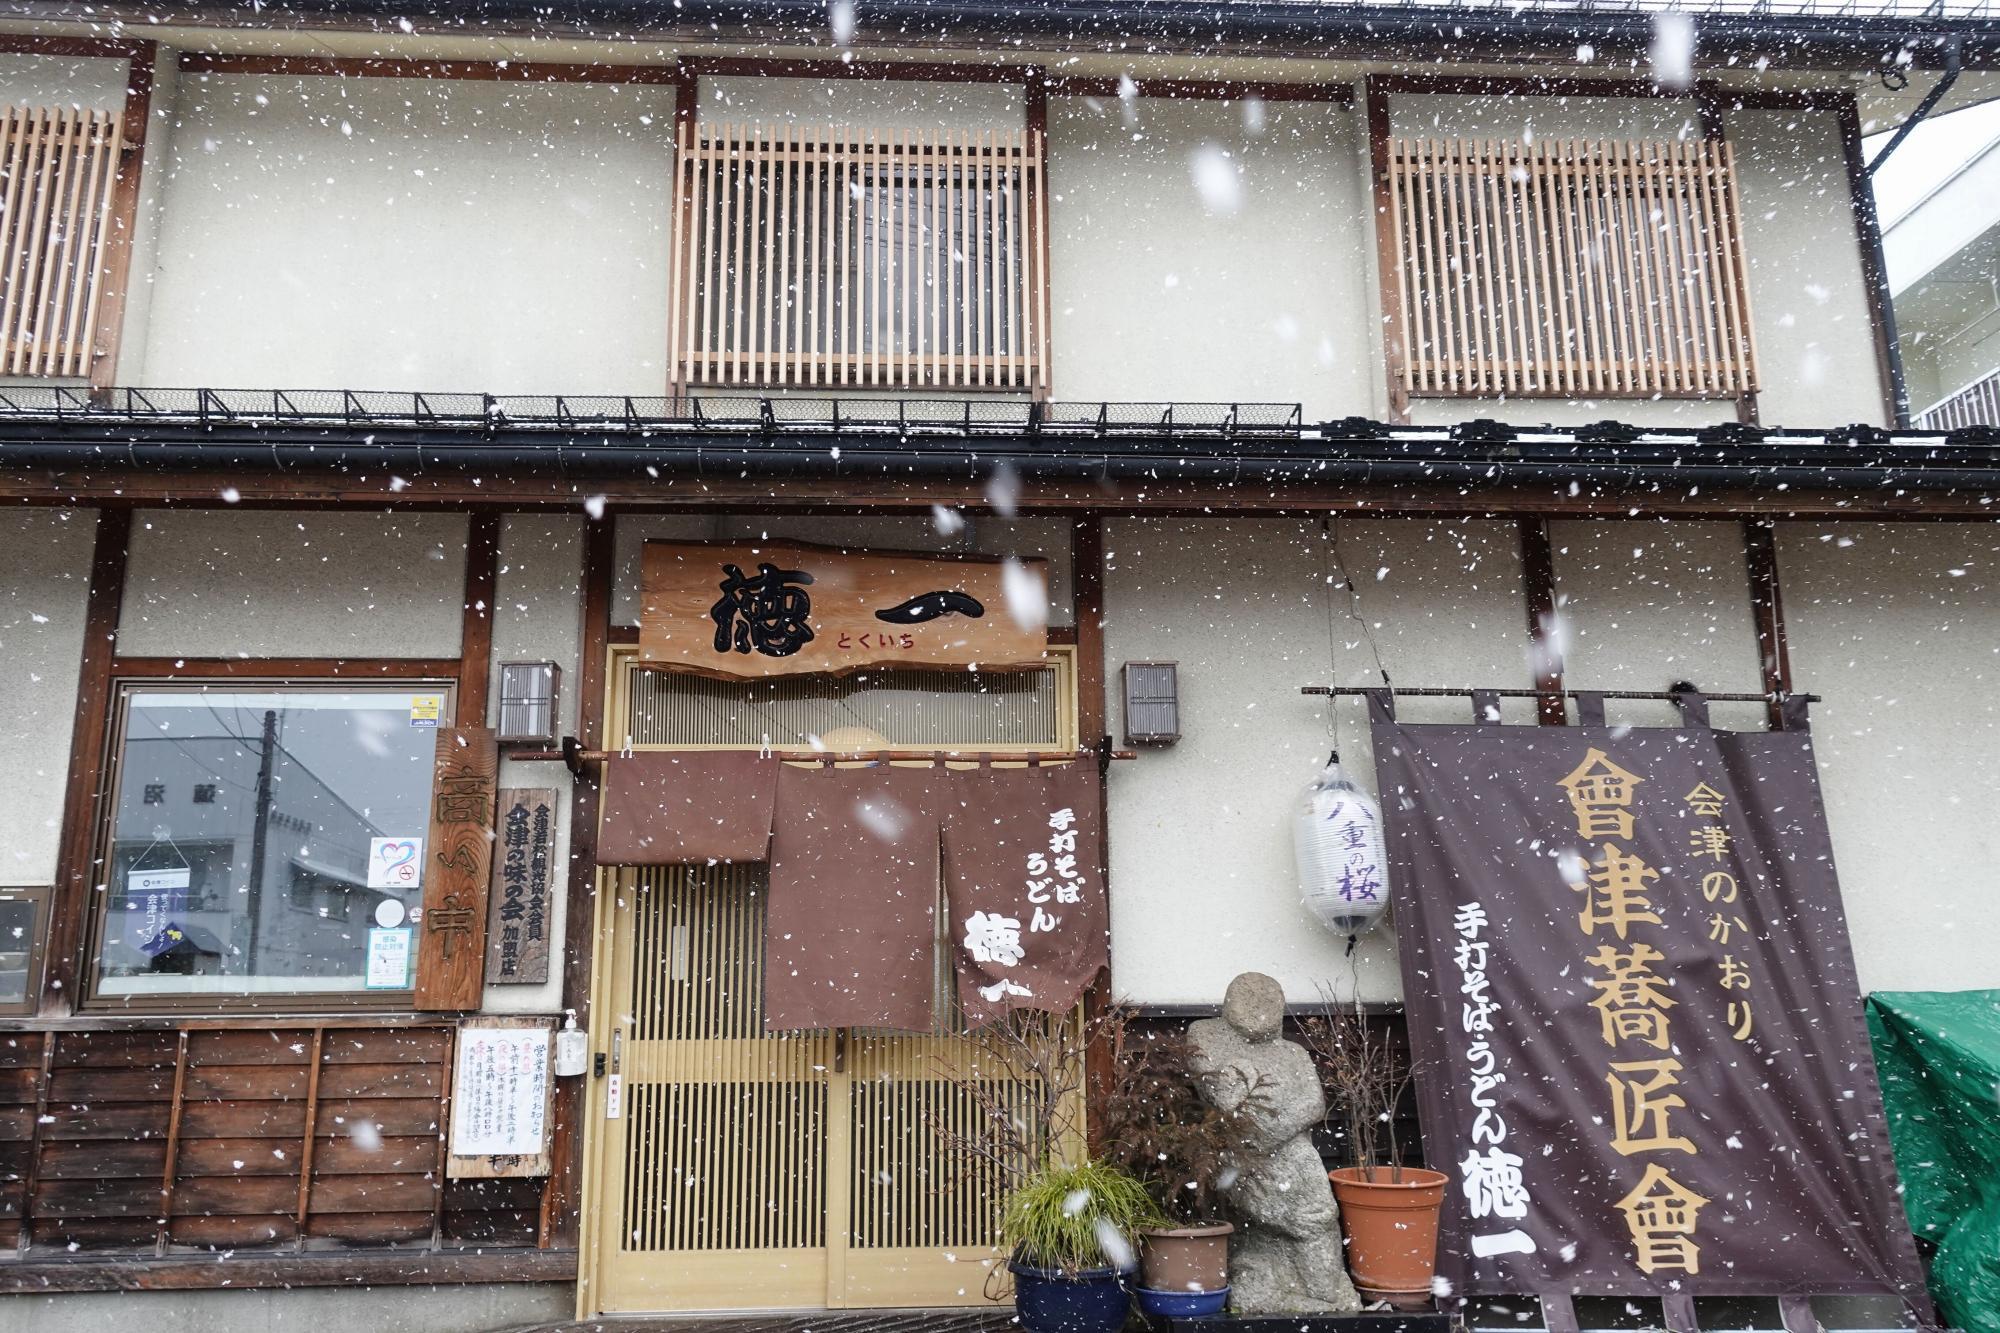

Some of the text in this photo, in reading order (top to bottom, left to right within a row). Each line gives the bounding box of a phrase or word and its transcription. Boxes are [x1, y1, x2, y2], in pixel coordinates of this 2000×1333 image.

[837, 632, 915, 650] とくいち
[427, 766, 490, 960] 商い中
[1026, 852, 1055, 932] うどん
[1049, 808, 1086, 903] 手打そば
[1684, 781, 1755, 1041] 会津のかおり
[1556, 746, 1712, 1275] 會津蕎匠會
